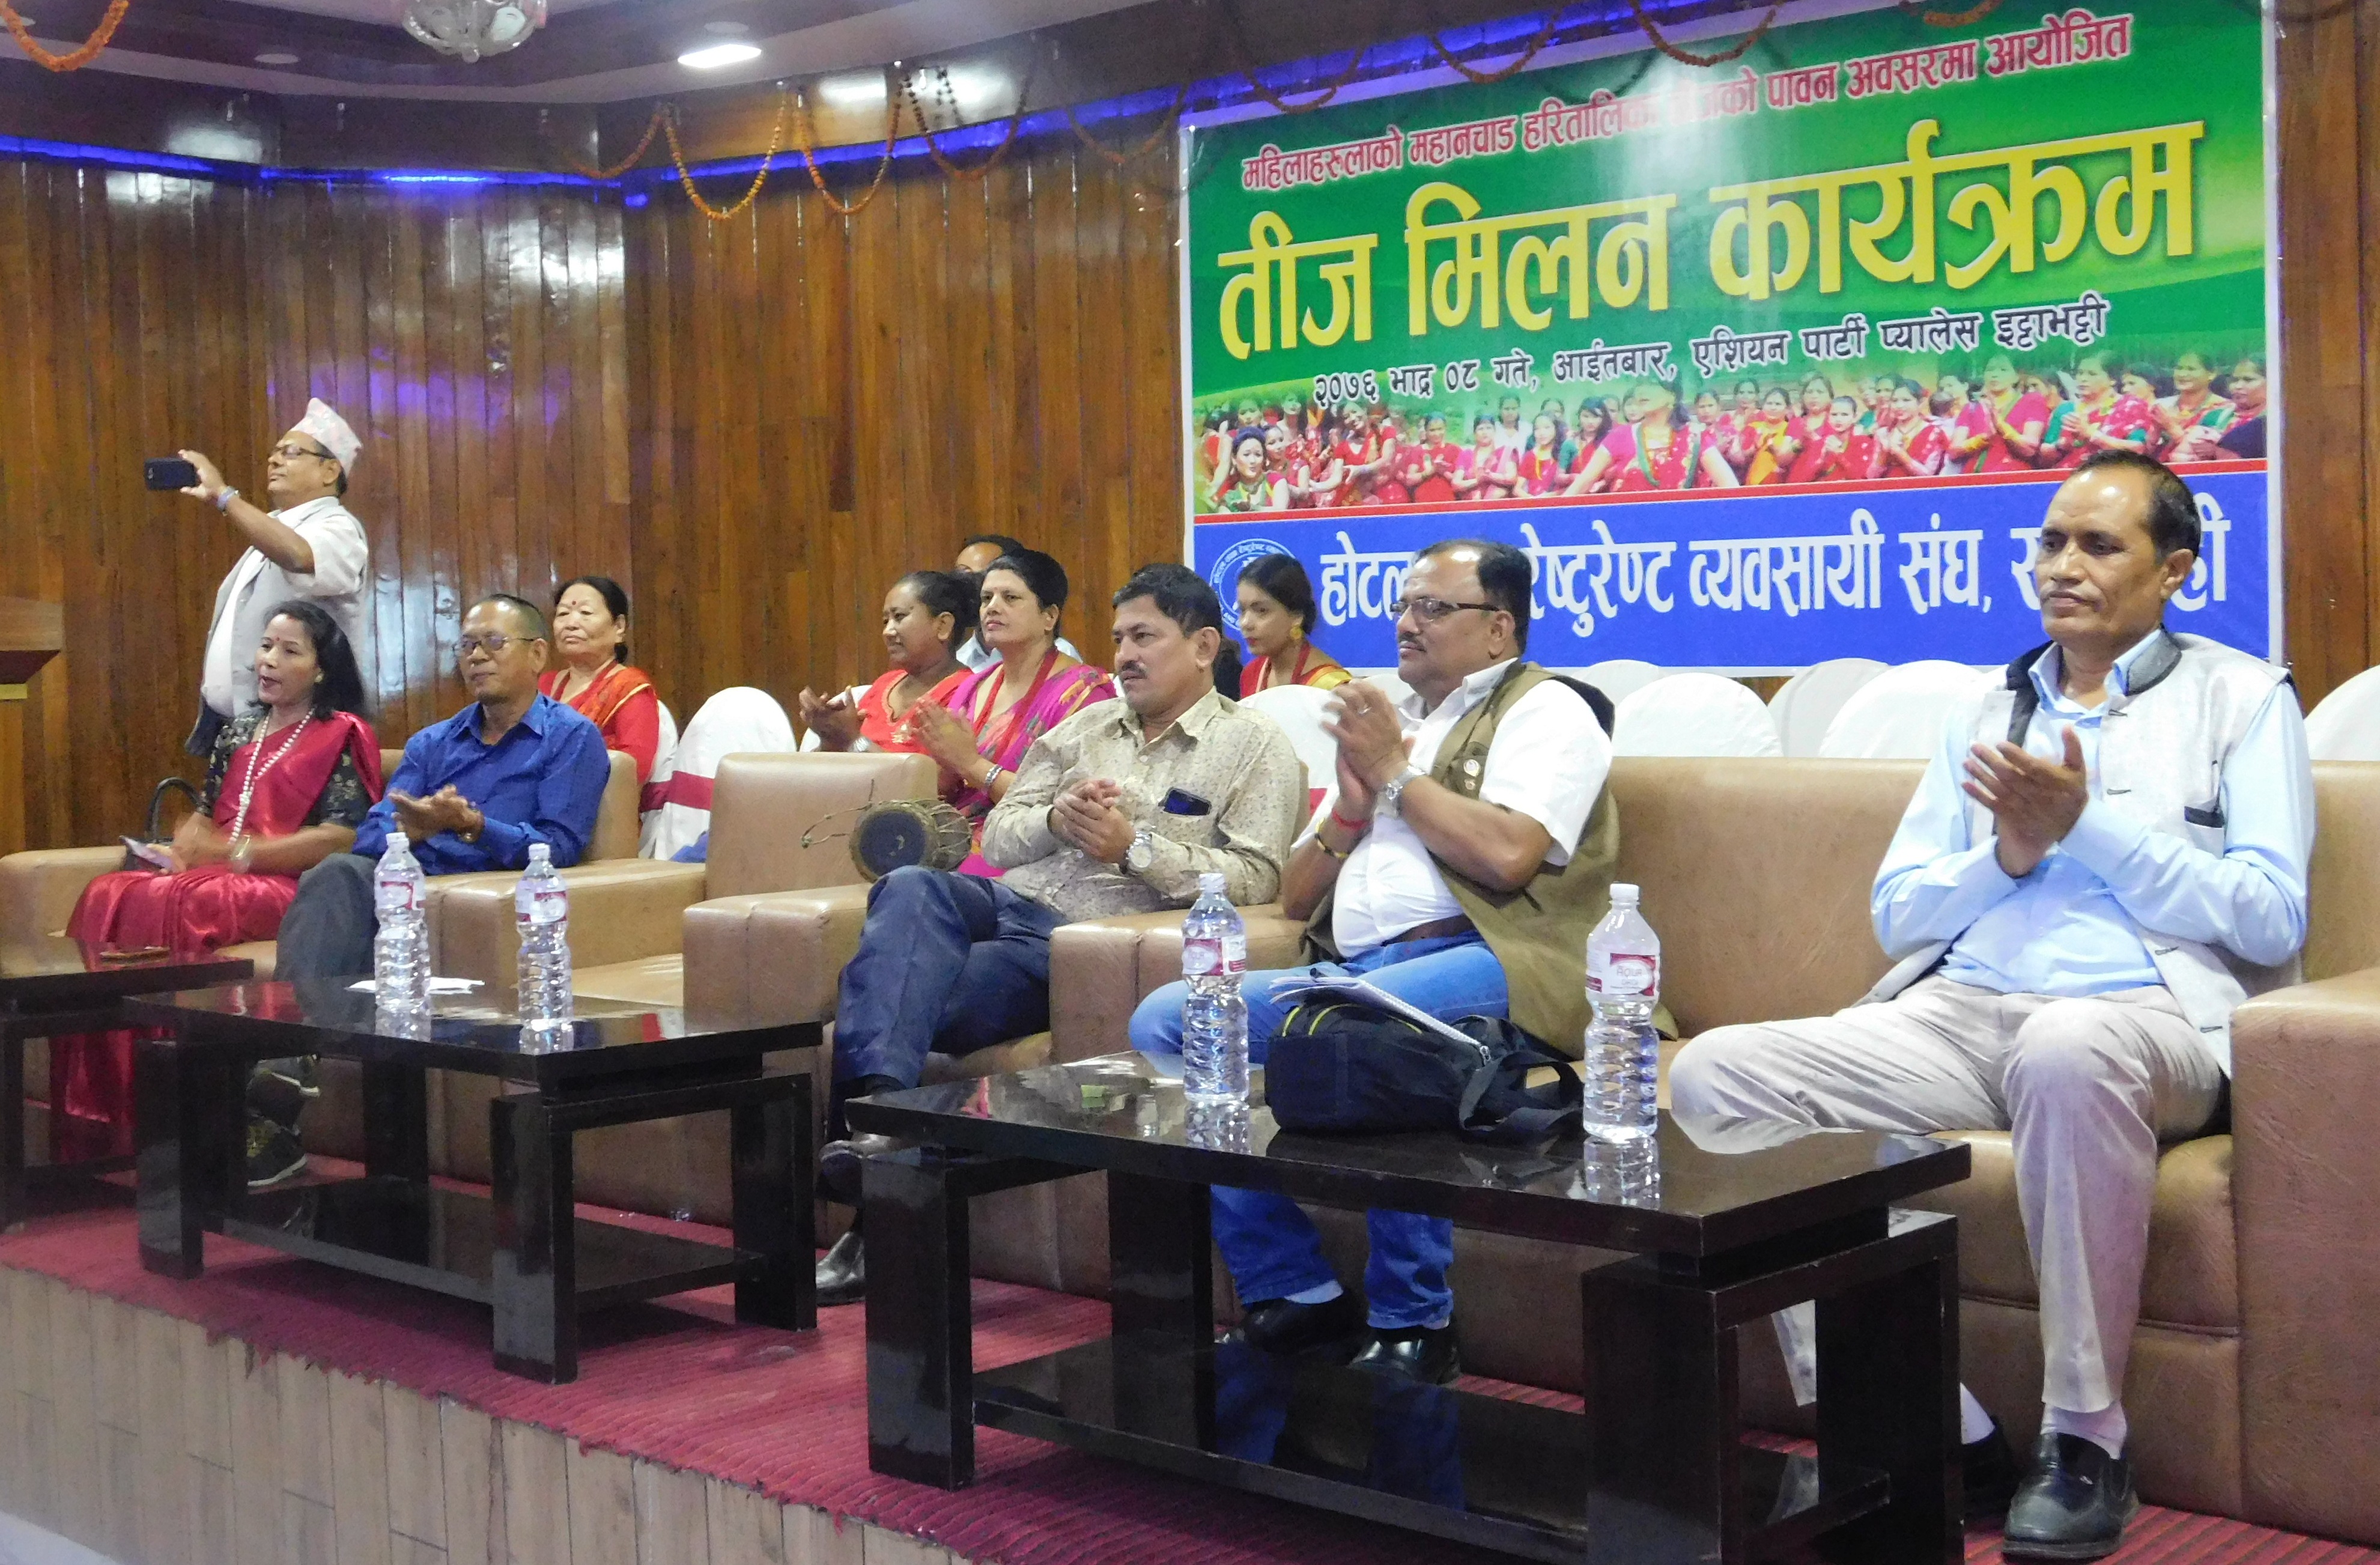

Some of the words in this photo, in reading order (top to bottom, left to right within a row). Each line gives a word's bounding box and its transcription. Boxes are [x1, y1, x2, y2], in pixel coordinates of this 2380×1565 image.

[1766, 64, 1838, 107] पावन
[1847, 41, 1977, 97] अवसरमा
[1987, 10, 2131, 75] आयोजित
[1217, 210, 1378, 360] तीज
[1404, 181, 1677, 338] मिलन
[1708, 119, 2205, 300] कार्यक्रम
[1314, 372, 1378, 405] २०७६
[1390, 365, 1434, 397] भाद्र
[1690, 327, 1790, 376] एशियन
[1802, 314, 1866, 359] पार्टी
[1880, 308, 1981, 352] प्यालेस
[1689, 508, 1885, 617] व्यवसायी
[1898, 512, 1992, 615] संघ,
